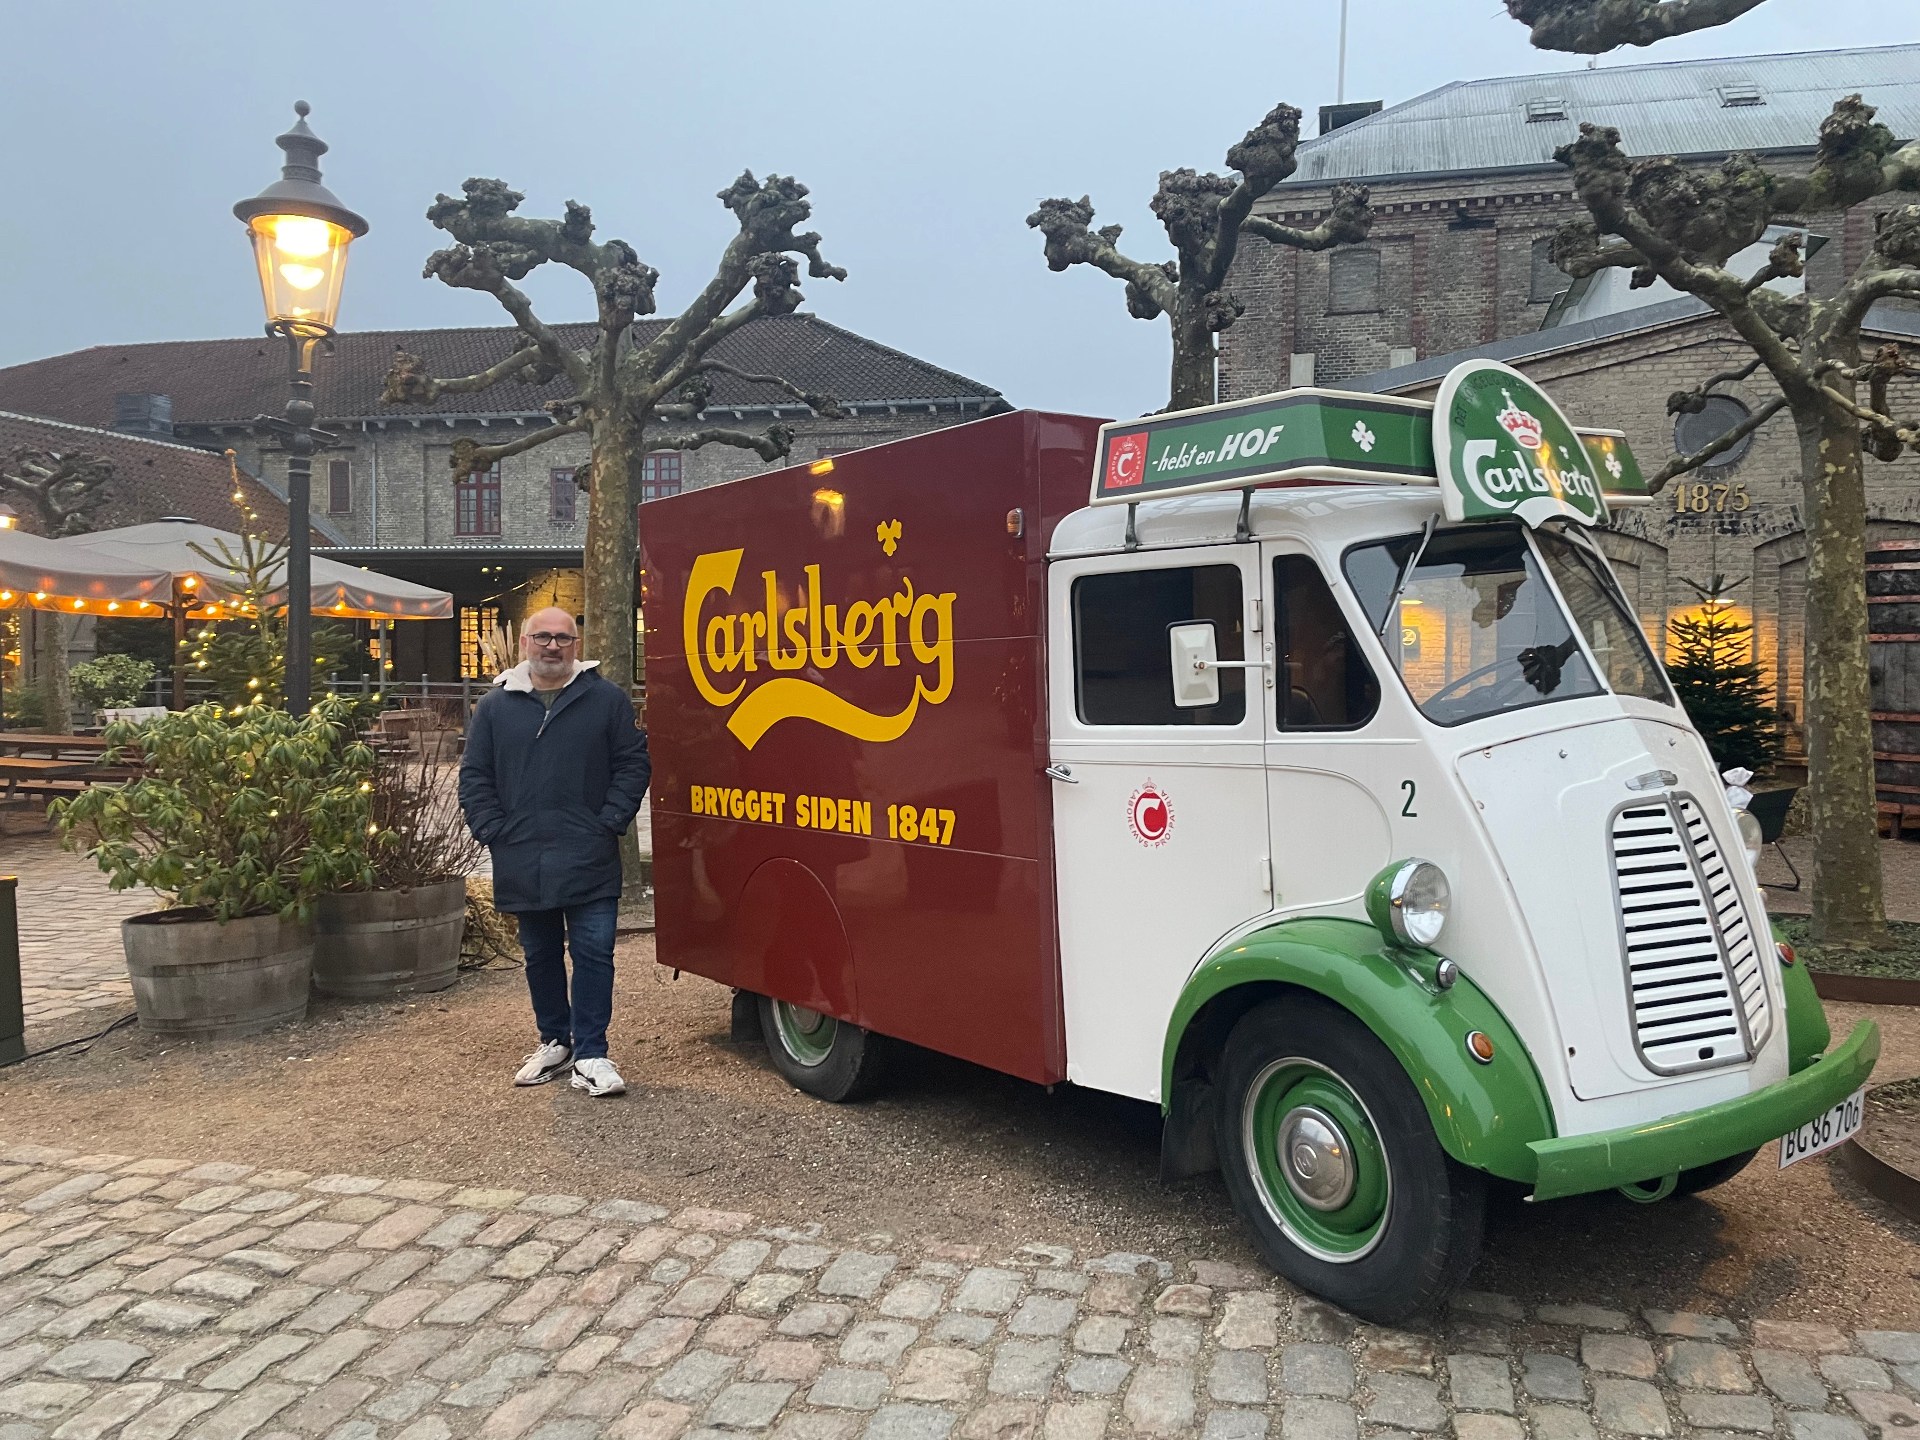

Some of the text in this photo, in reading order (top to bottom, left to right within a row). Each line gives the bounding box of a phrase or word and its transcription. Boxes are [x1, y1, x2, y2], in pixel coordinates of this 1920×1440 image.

[1216, 425, 1284, 462] HOF
[1463, 440, 1601, 515] Carlsberg
[1673, 483, 1750, 513] 1875
[684, 548, 957, 706] Carlsberg
[690, 785, 956, 846] BRYGGET SIDEN 1847
[1401, 779, 1418, 817] 2
[1811, 1111, 1831, 1148] 86
[1835, 1096, 1860, 1138] 706
